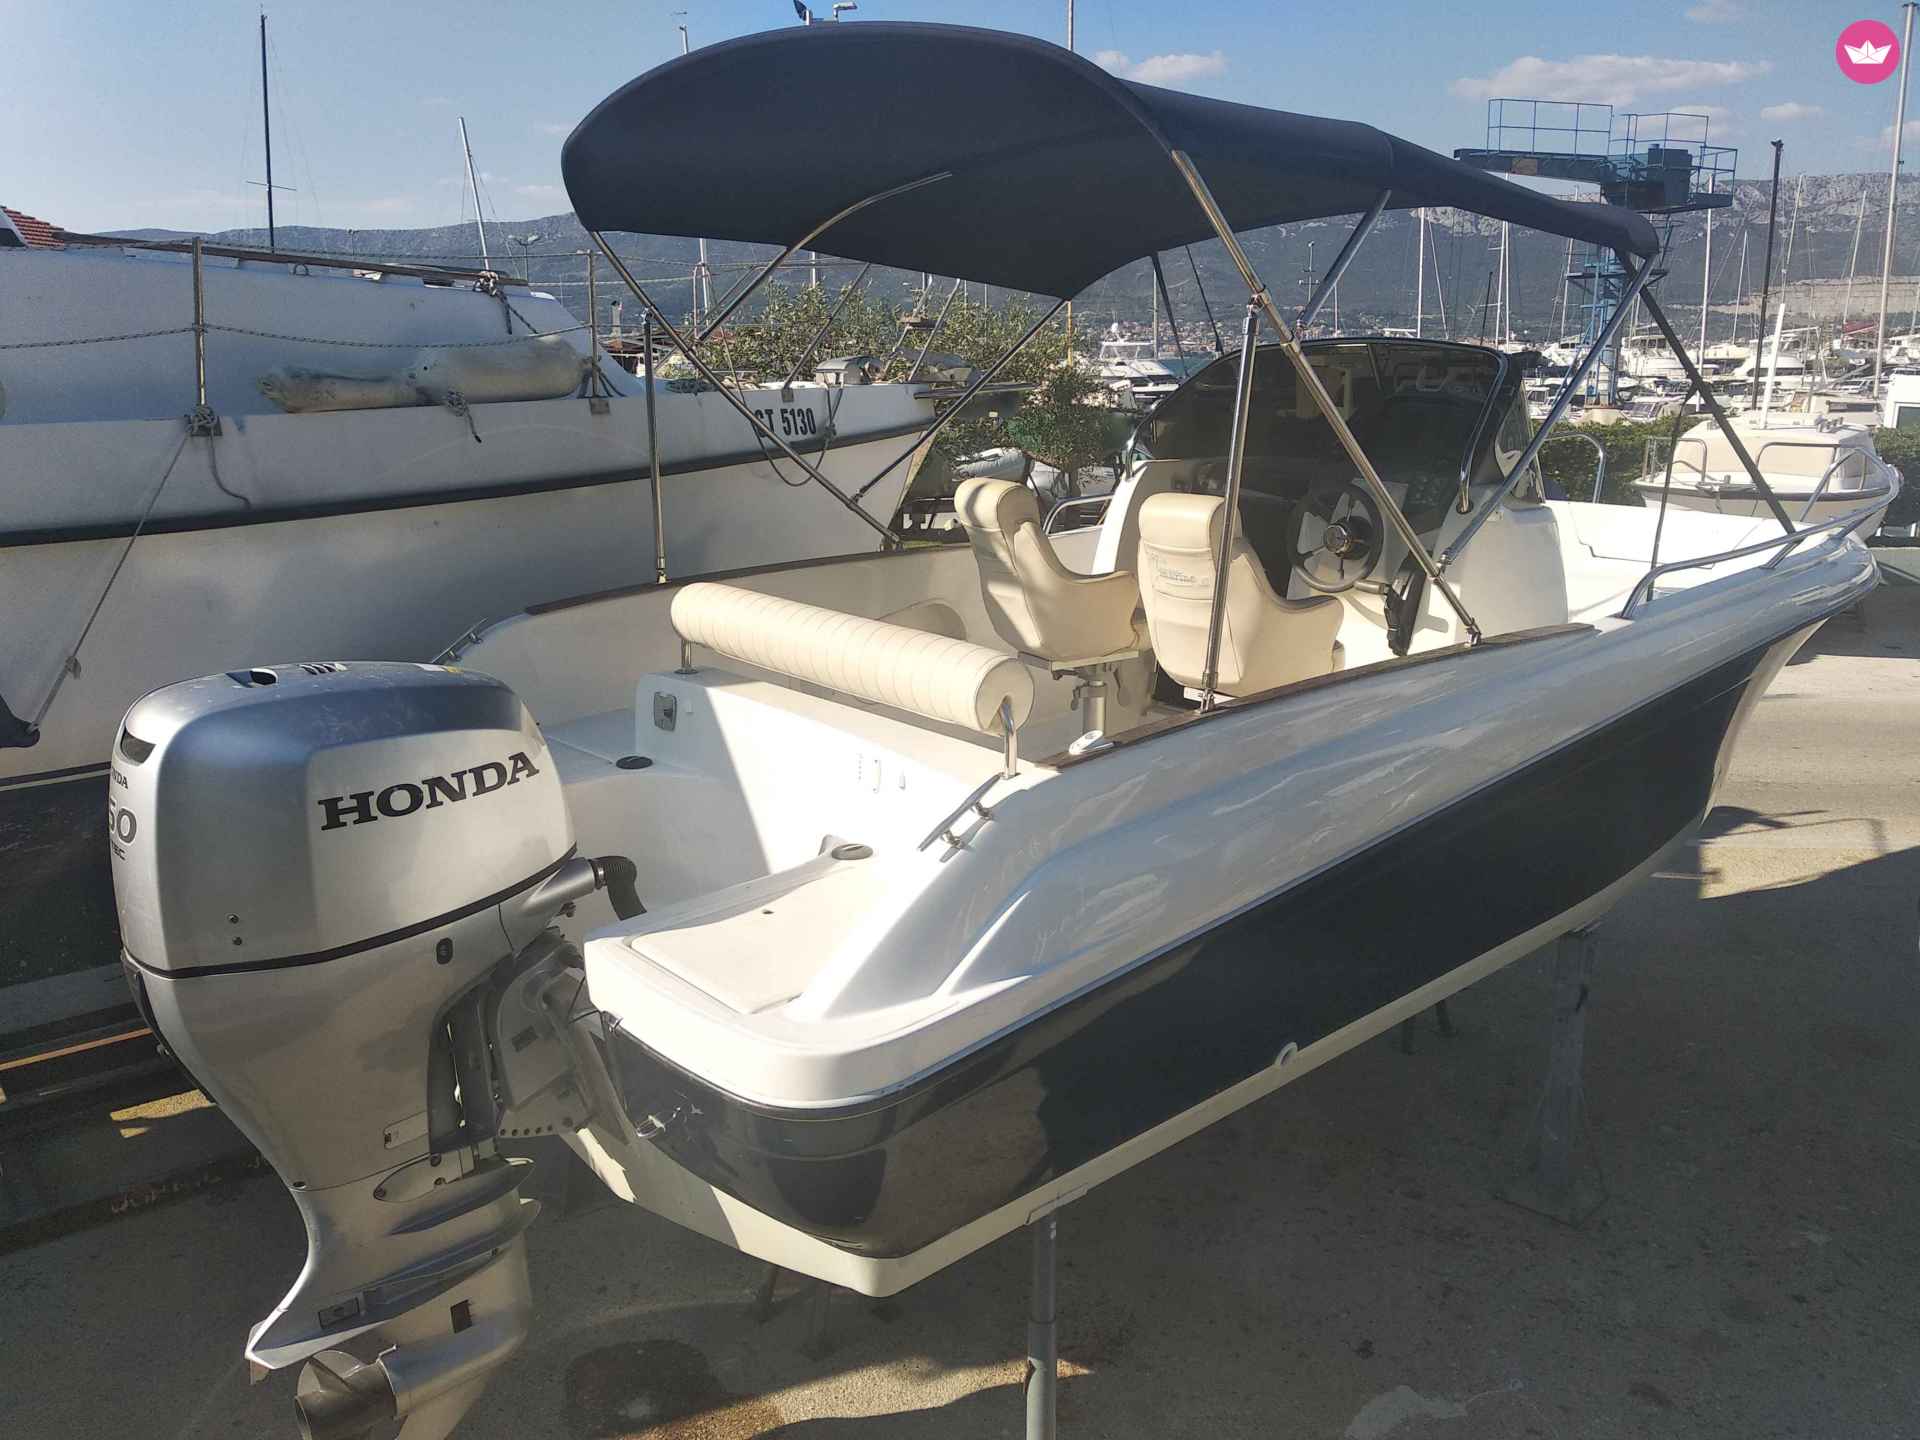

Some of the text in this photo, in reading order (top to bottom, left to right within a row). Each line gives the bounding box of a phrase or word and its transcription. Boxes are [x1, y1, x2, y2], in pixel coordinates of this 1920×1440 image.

[780, 407, 817, 436] 5130
[111, 766, 129, 790] NDA
[317, 751, 540, 831] HONDA
